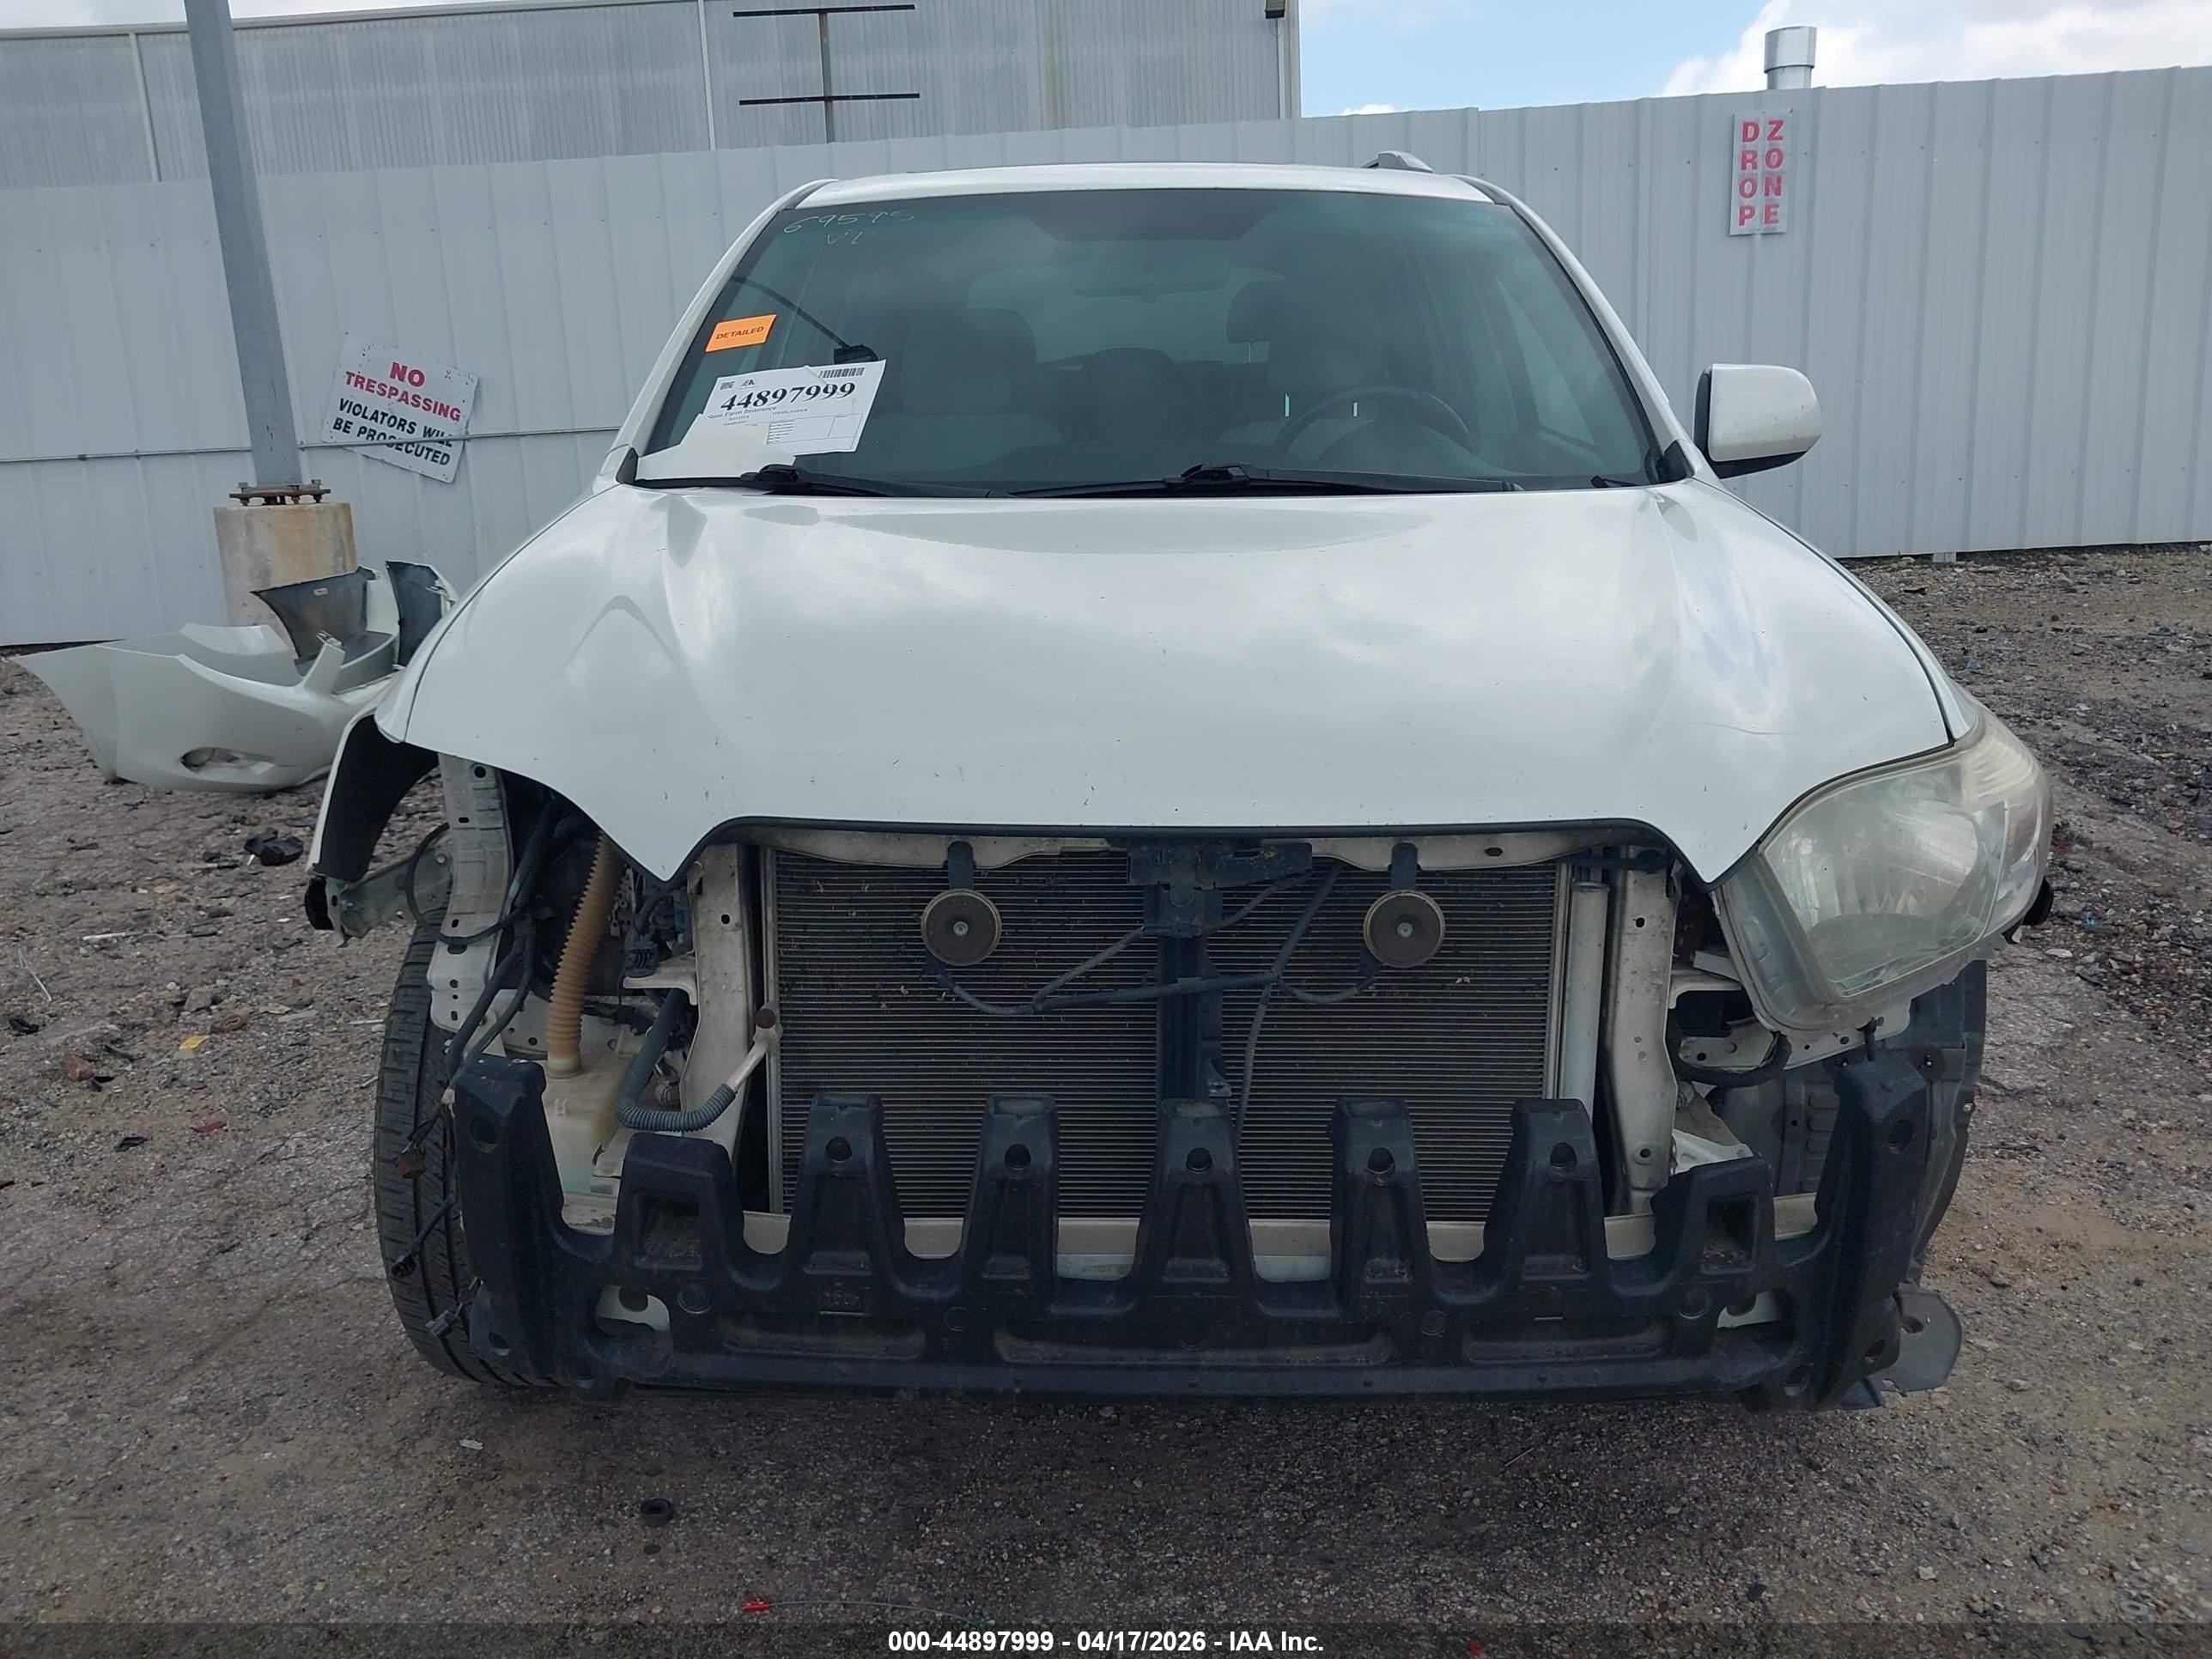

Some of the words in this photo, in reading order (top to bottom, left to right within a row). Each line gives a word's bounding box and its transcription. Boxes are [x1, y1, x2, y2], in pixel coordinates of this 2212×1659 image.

[1738, 121, 1760, 227] DROP
[1763, 119, 1784, 225] ZONE
[715, 326, 764, 340] DETAILED
[389, 362, 425, 387] NO
[345, 371, 461, 422] TRESPASSING
[720, 382, 856, 411] 44897999
[332, 416, 354, 434] BE
[338, 398, 417, 434] VIOLATORS
